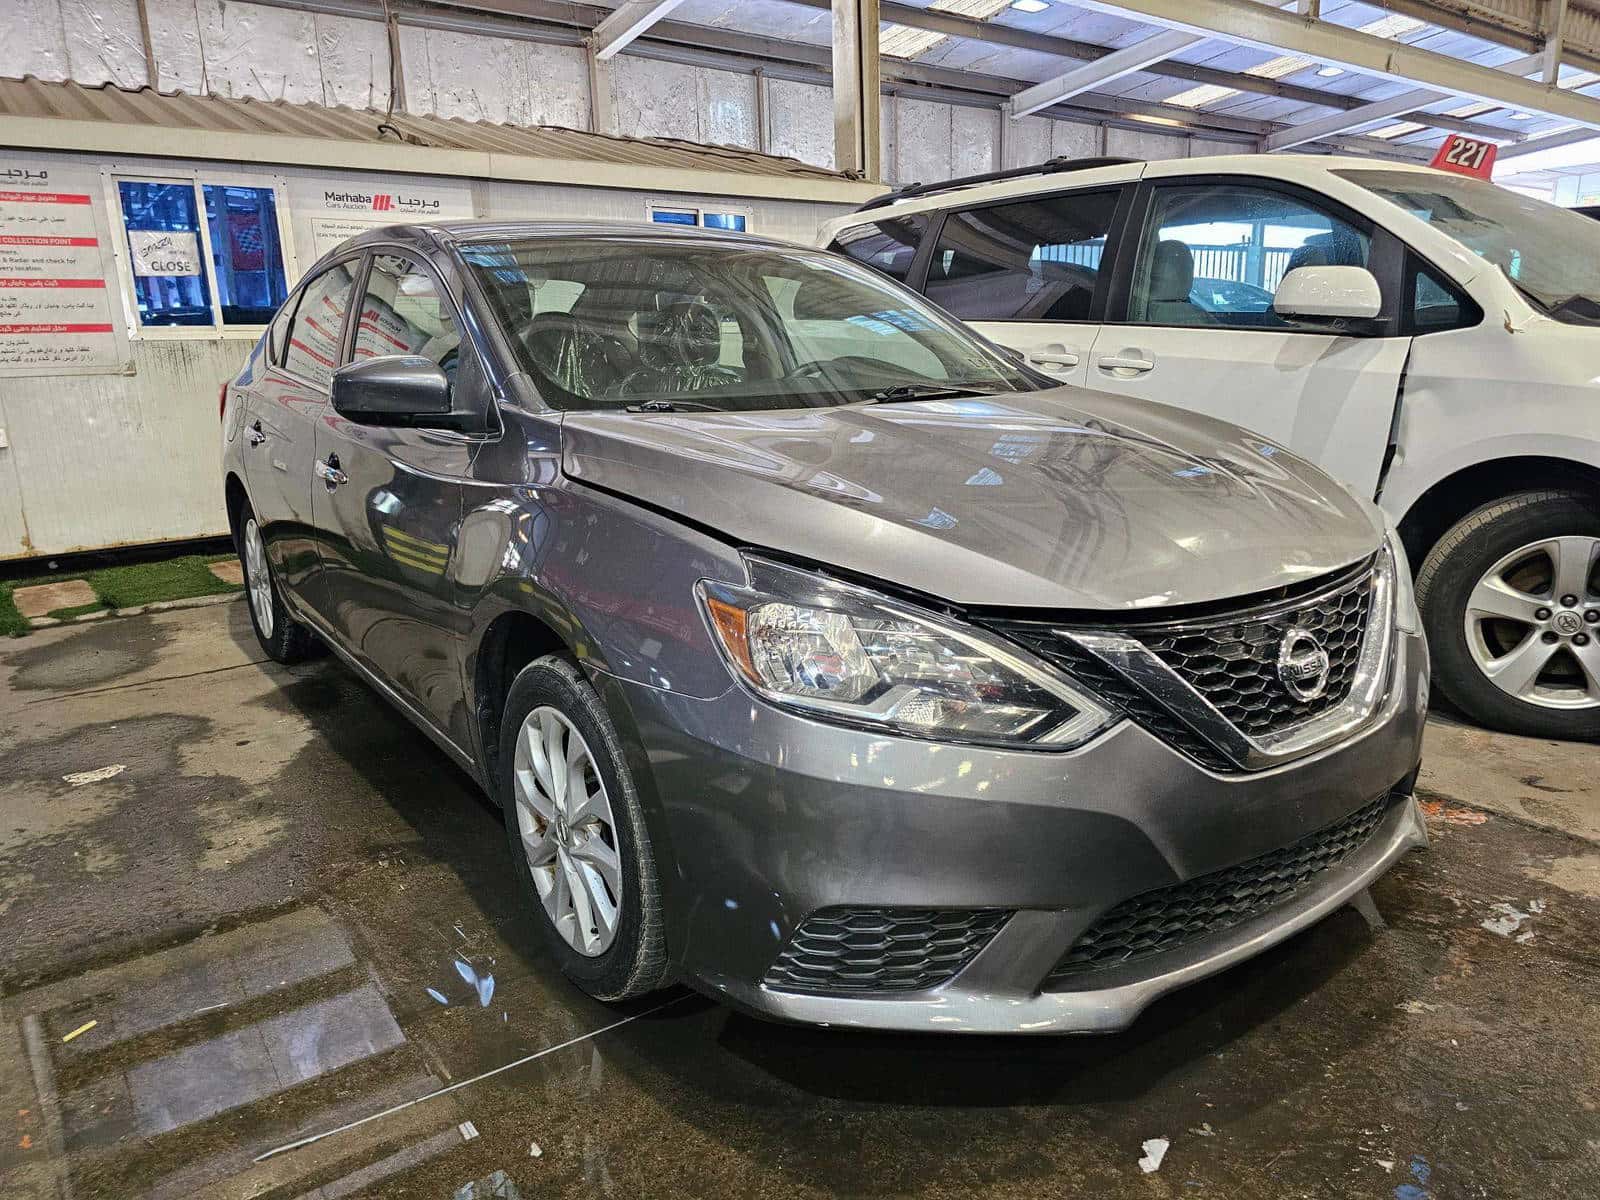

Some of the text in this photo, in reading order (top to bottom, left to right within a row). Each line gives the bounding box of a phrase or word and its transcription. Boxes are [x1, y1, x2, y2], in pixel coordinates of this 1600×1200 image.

[1445, 138, 1489, 169] 221
[324, 191, 372, 204] Marhaba
[398, 195, 440, 208] مرحبا
[325, 201, 367, 210] Cars Auction
[3, 236, 72, 245] COLLECTION POINT
[66, 257, 77, 265] for
